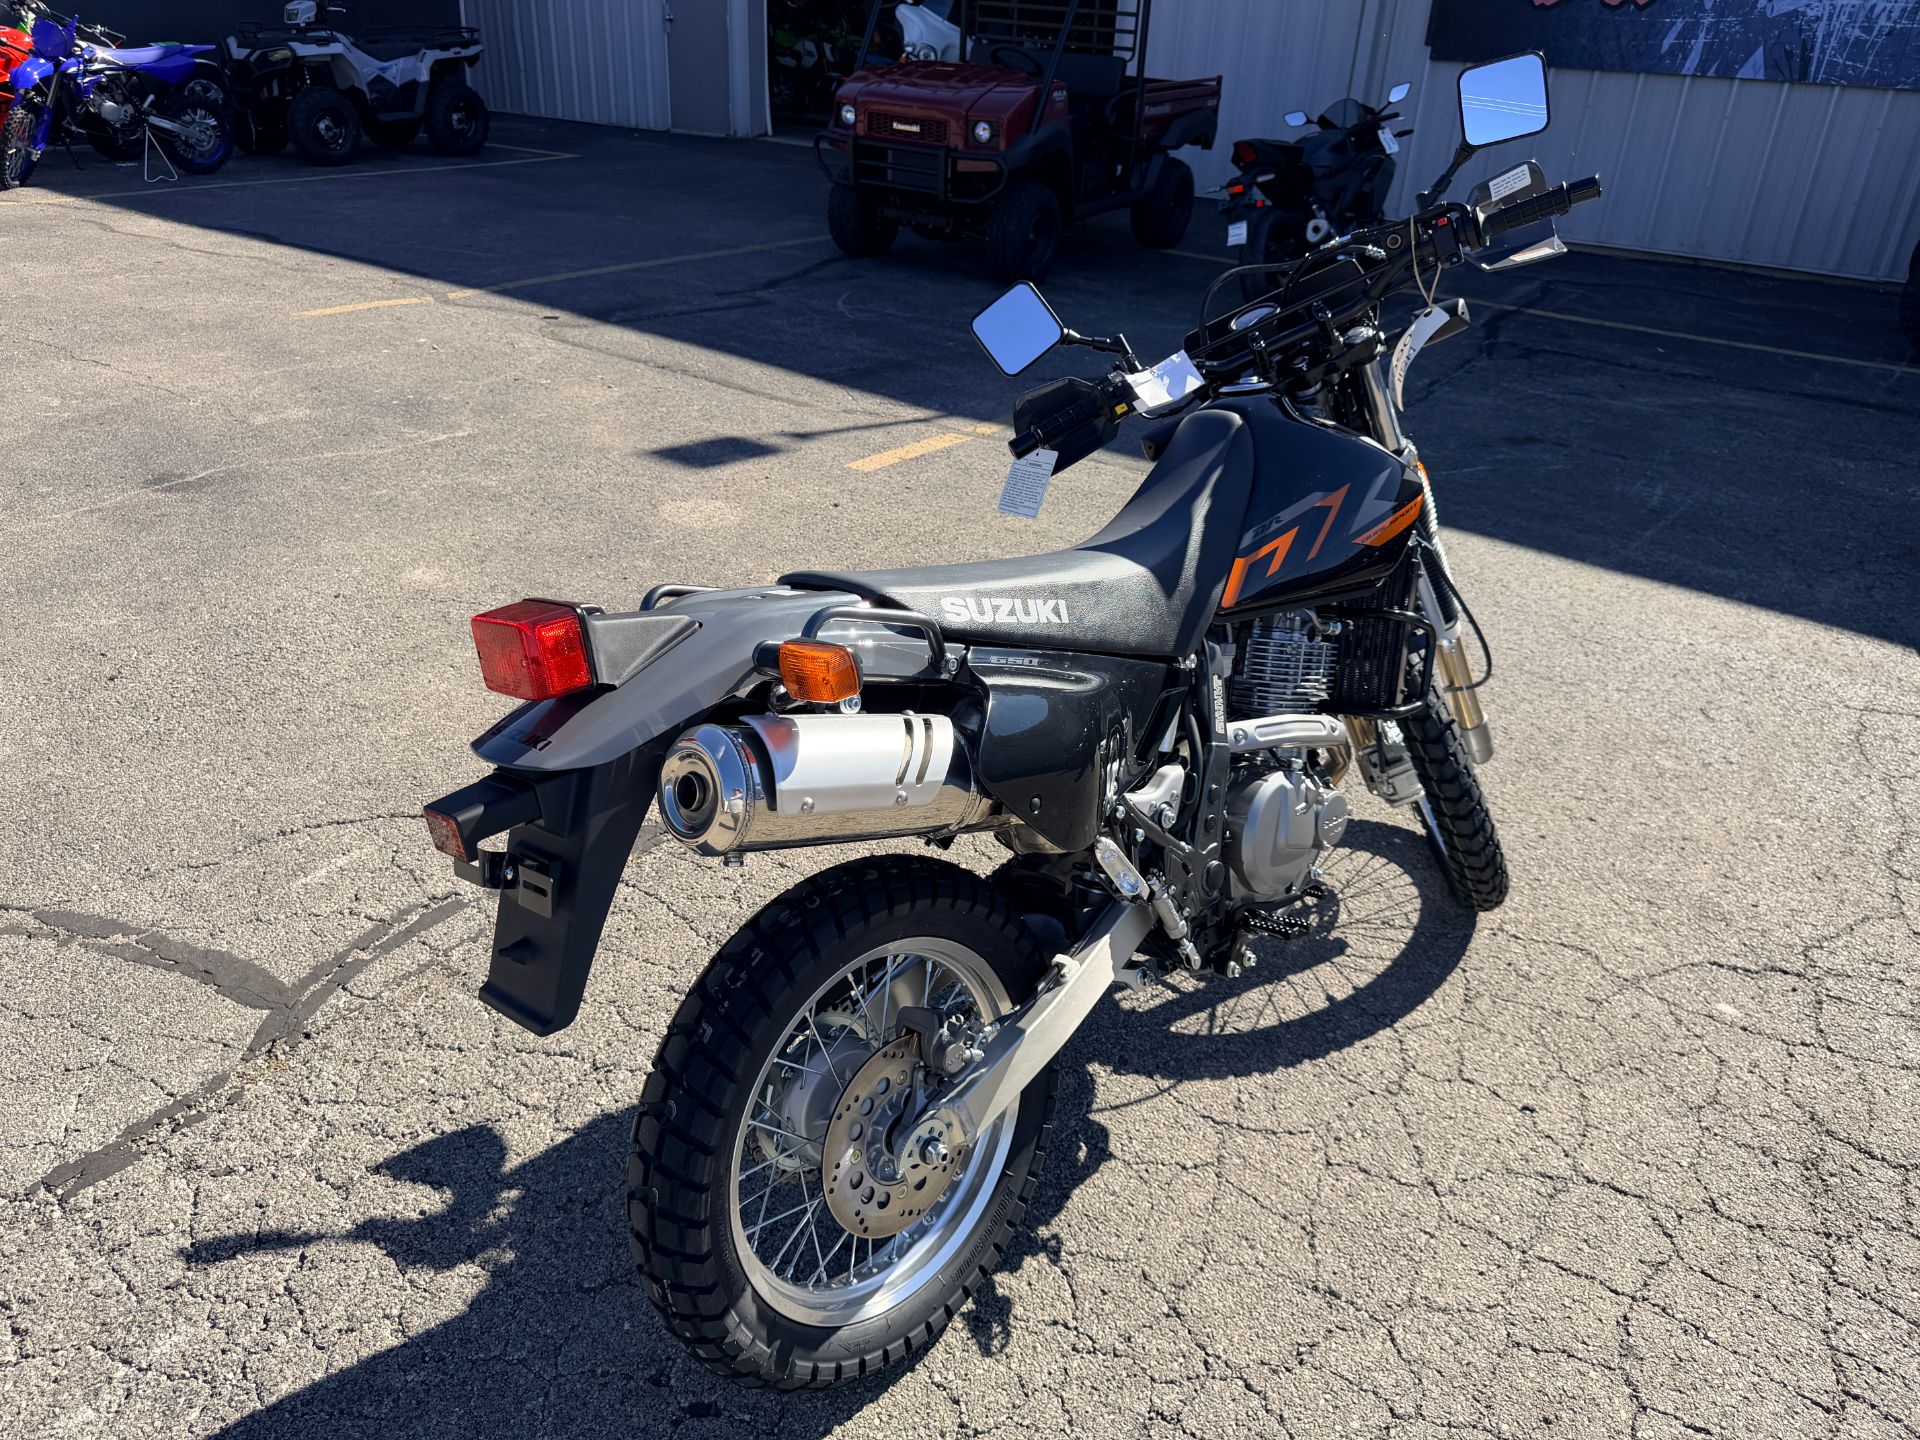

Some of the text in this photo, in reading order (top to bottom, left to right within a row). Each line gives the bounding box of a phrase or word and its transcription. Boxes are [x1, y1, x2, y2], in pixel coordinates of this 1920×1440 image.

[1251, 514, 1287, 540] DR
[941, 597, 1070, 624] SUZUKI
[990, 656, 1040, 667] 650
